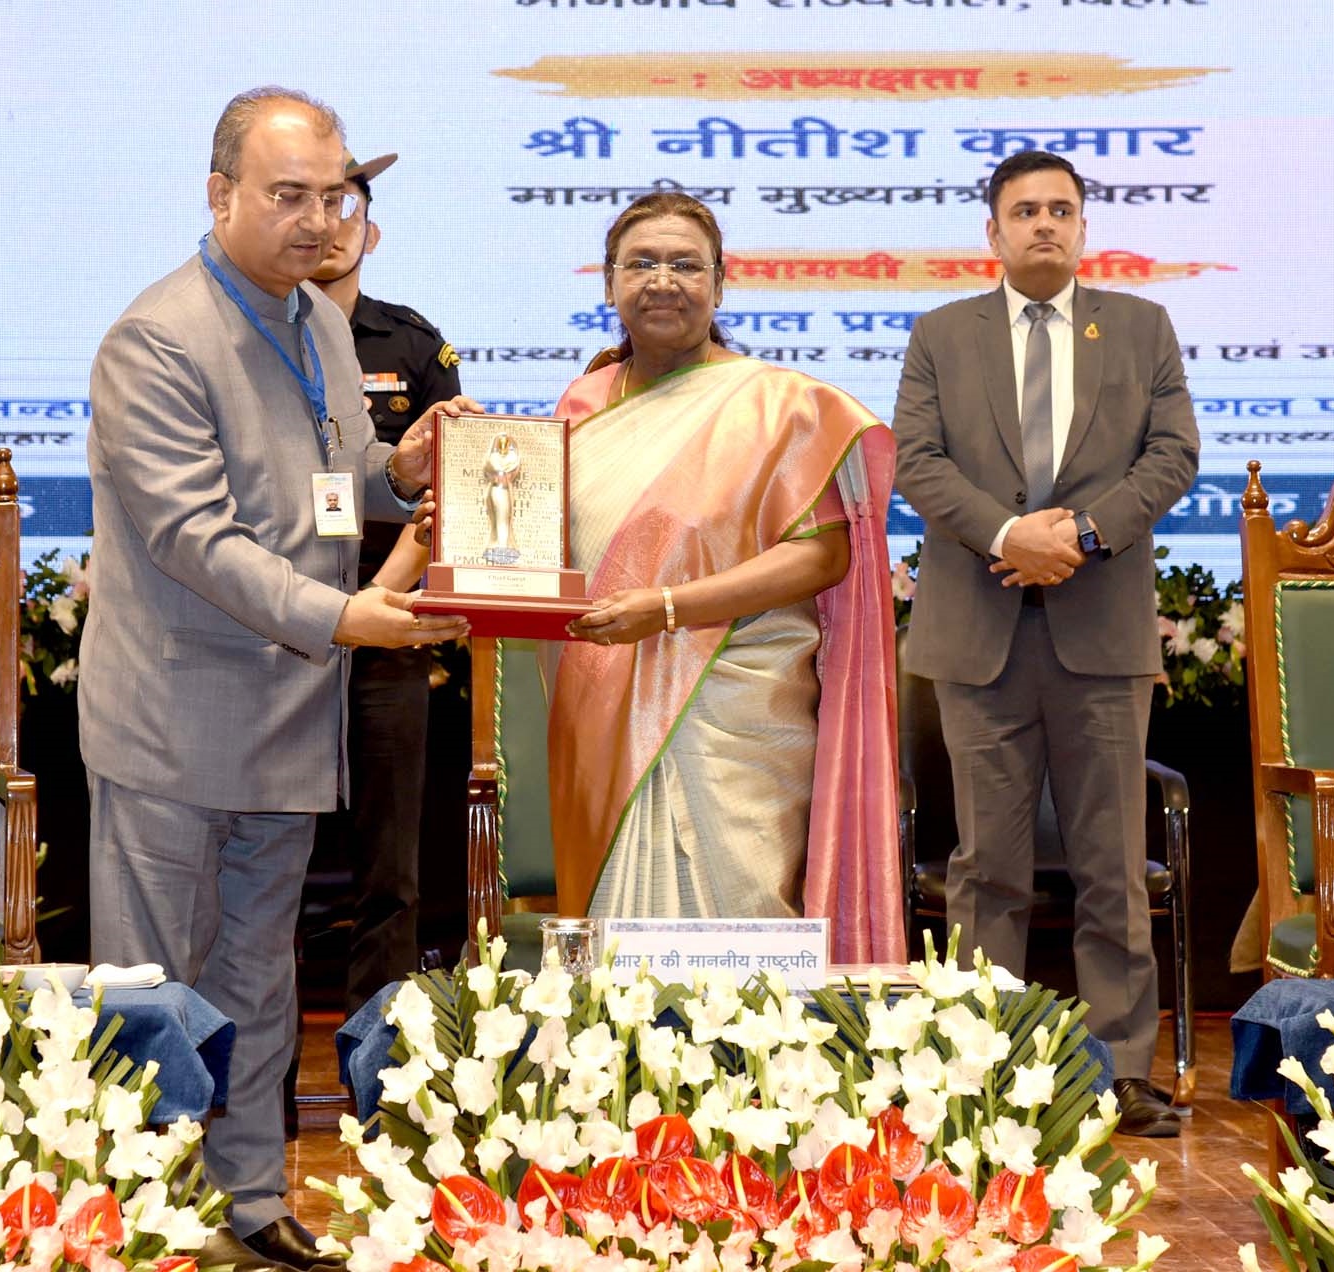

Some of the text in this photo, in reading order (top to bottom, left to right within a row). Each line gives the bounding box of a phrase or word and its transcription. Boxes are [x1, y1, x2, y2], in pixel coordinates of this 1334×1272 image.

[739, 67, 984, 93] अध्यक्षता
[521, 116, 1203, 168] श्री नीतीश कुमार
[1217, 338, 1283, 361] एवं
[660, 950, 680, 968] की
[687, 950, 749, 968] माननीय
[756, 950, 817, 971] राष्ट्रपति
